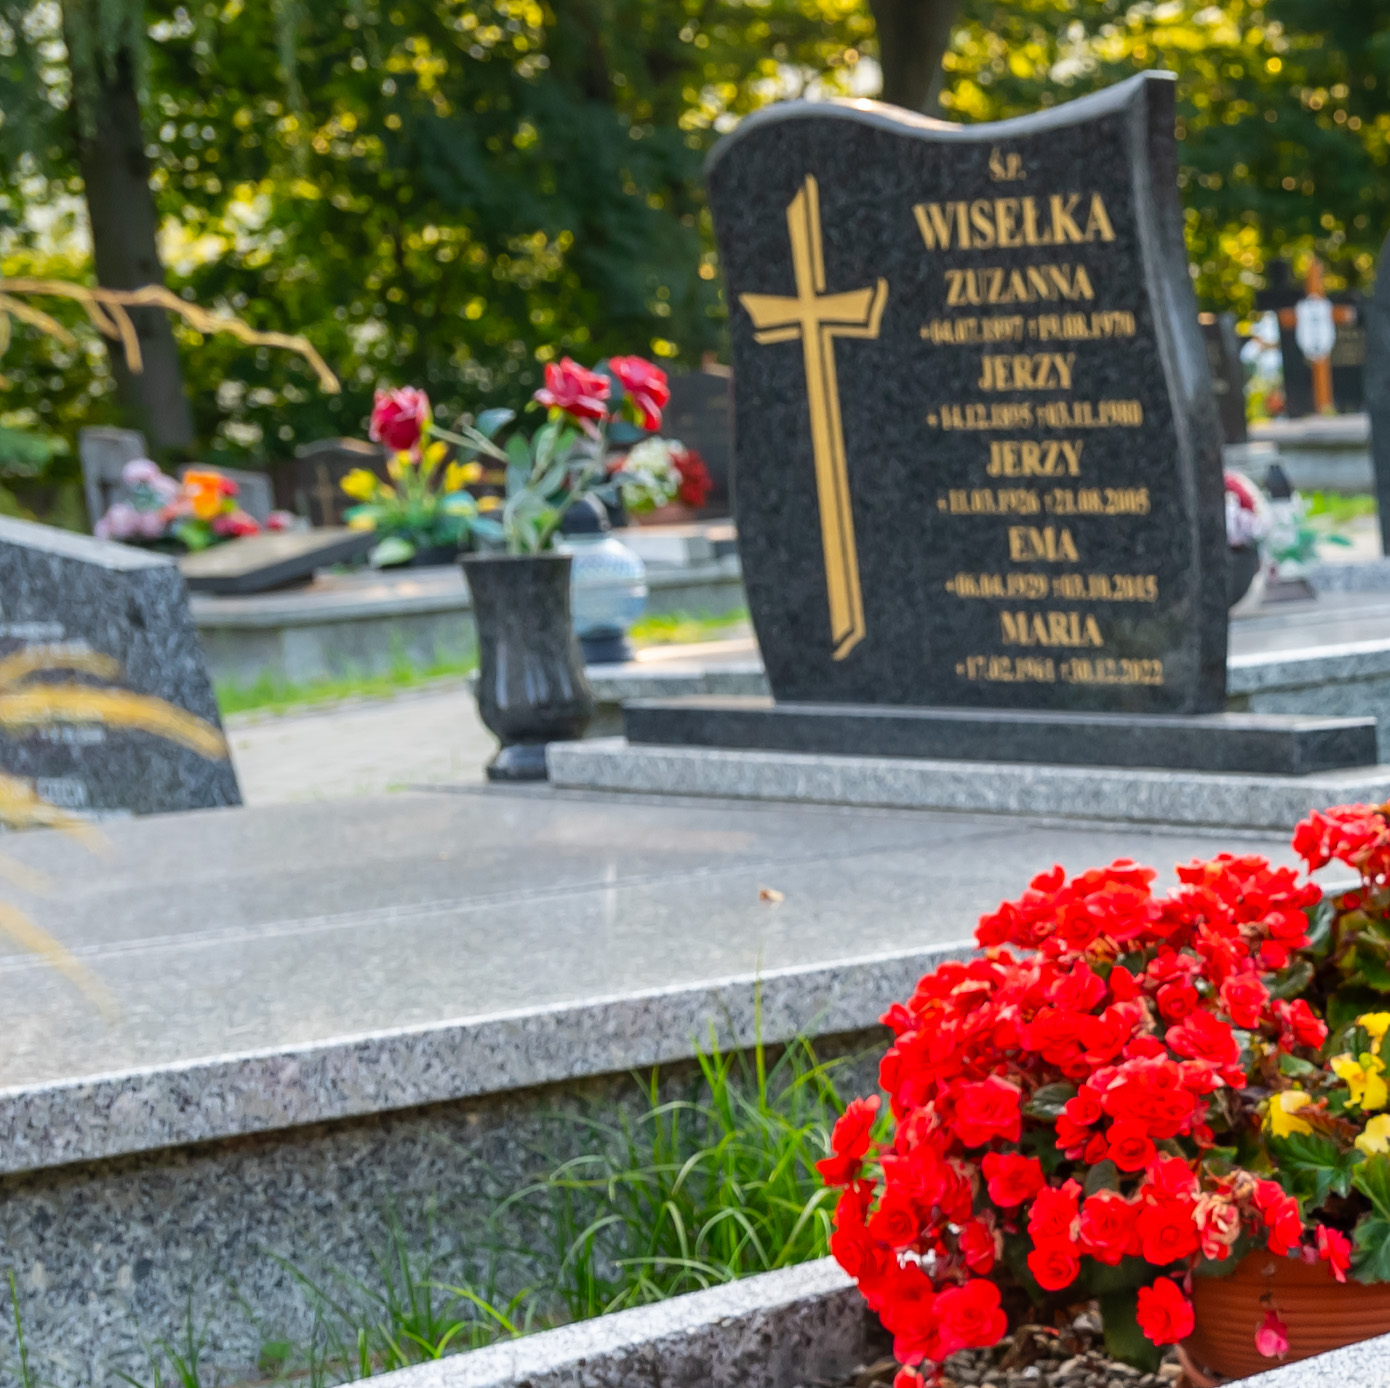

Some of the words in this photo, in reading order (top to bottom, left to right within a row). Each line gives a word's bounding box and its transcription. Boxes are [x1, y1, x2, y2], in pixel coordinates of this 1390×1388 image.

[912, 191, 1117, 251] WISEŁKA
[944, 263, 1095, 306] ZUZANNA
[978, 352, 1076, 391] JERZY
[986, 440, 1083, 478] JERZY
[1008, 526, 1080, 563] EMA
[1001, 611, 1104, 646] MARIA
